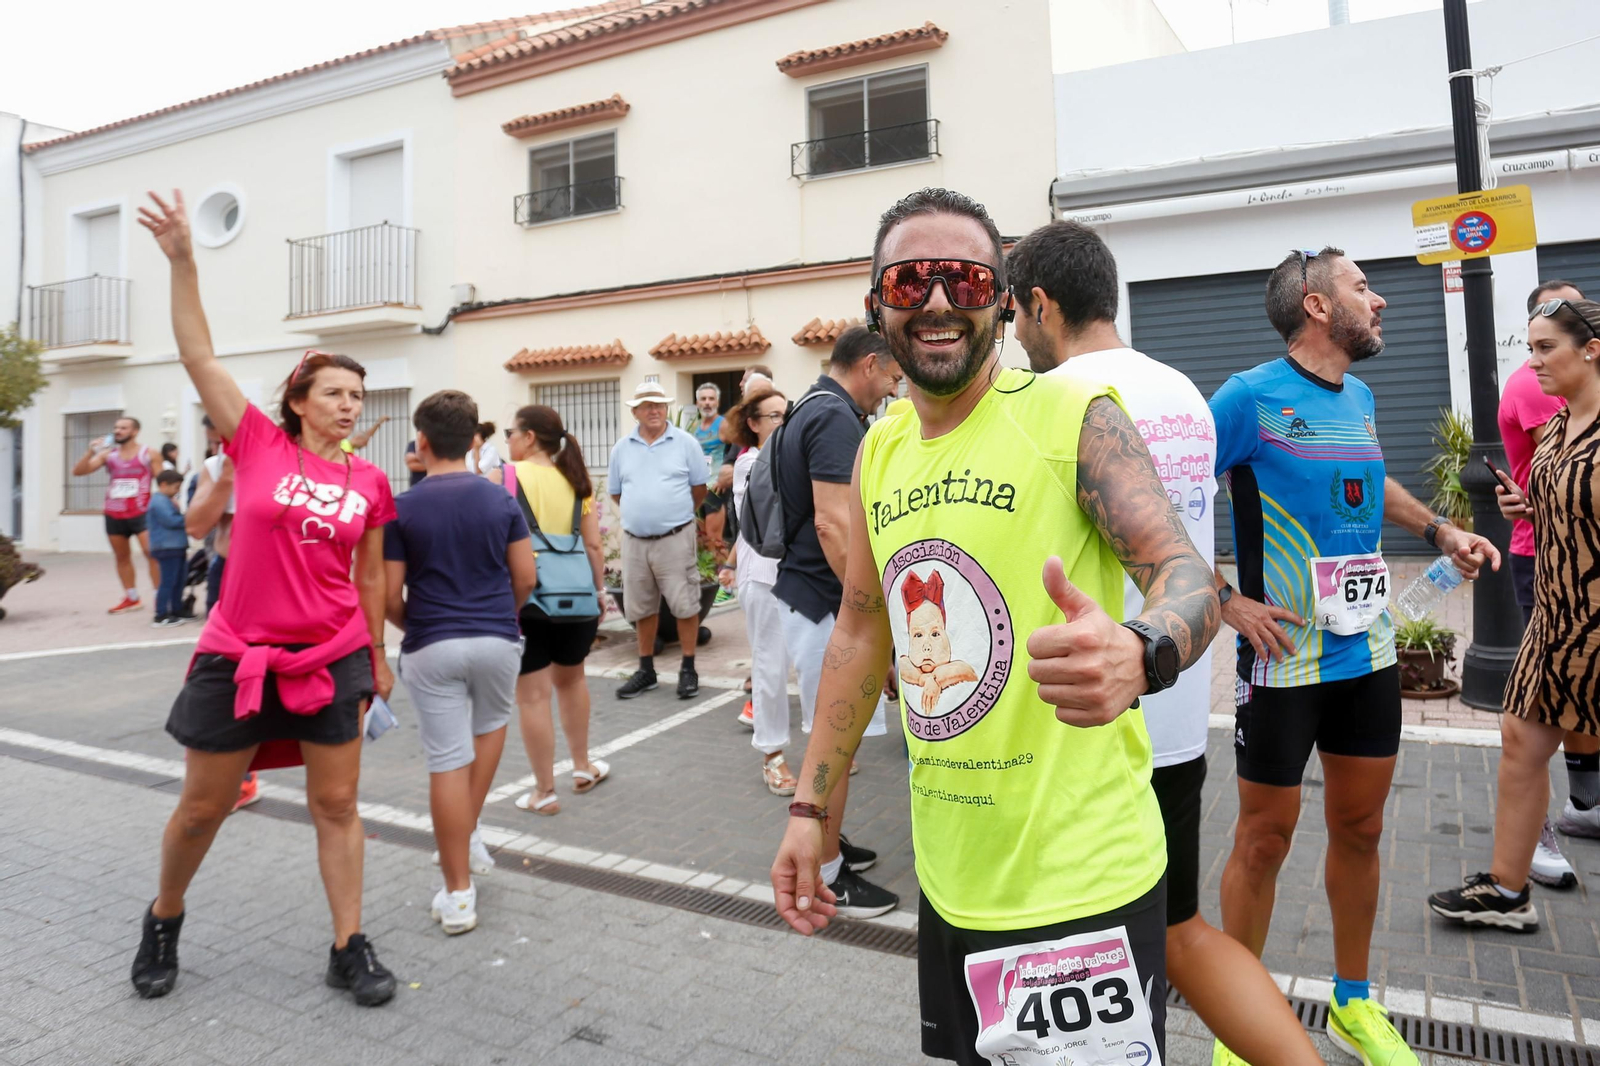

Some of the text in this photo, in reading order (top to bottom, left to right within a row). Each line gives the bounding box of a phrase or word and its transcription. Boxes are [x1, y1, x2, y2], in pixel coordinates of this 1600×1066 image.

[1502, 159, 1554, 172] Cruzcampo
[1588, 152, 1600, 162] Cr
[1425, 200, 1468, 212] AYUNTAMIENTO
[1478, 197, 1490, 205] LOS
[1490, 193, 1517, 203] BARRIOS
[1458, 224, 1489, 234] RETIRADA
[870, 469, 1016, 536] Valentina
[891, 541, 961, 574] Asociación
[1344, 575, 1387, 603] 674
[924, 720, 941, 736] de
[941, 659, 1008, 734] Valentina
[1016, 977, 1135, 1039] 403
[1063, 1039, 1088, 1050] JORGE
[1104, 1040, 1125, 1048] SENIOR
